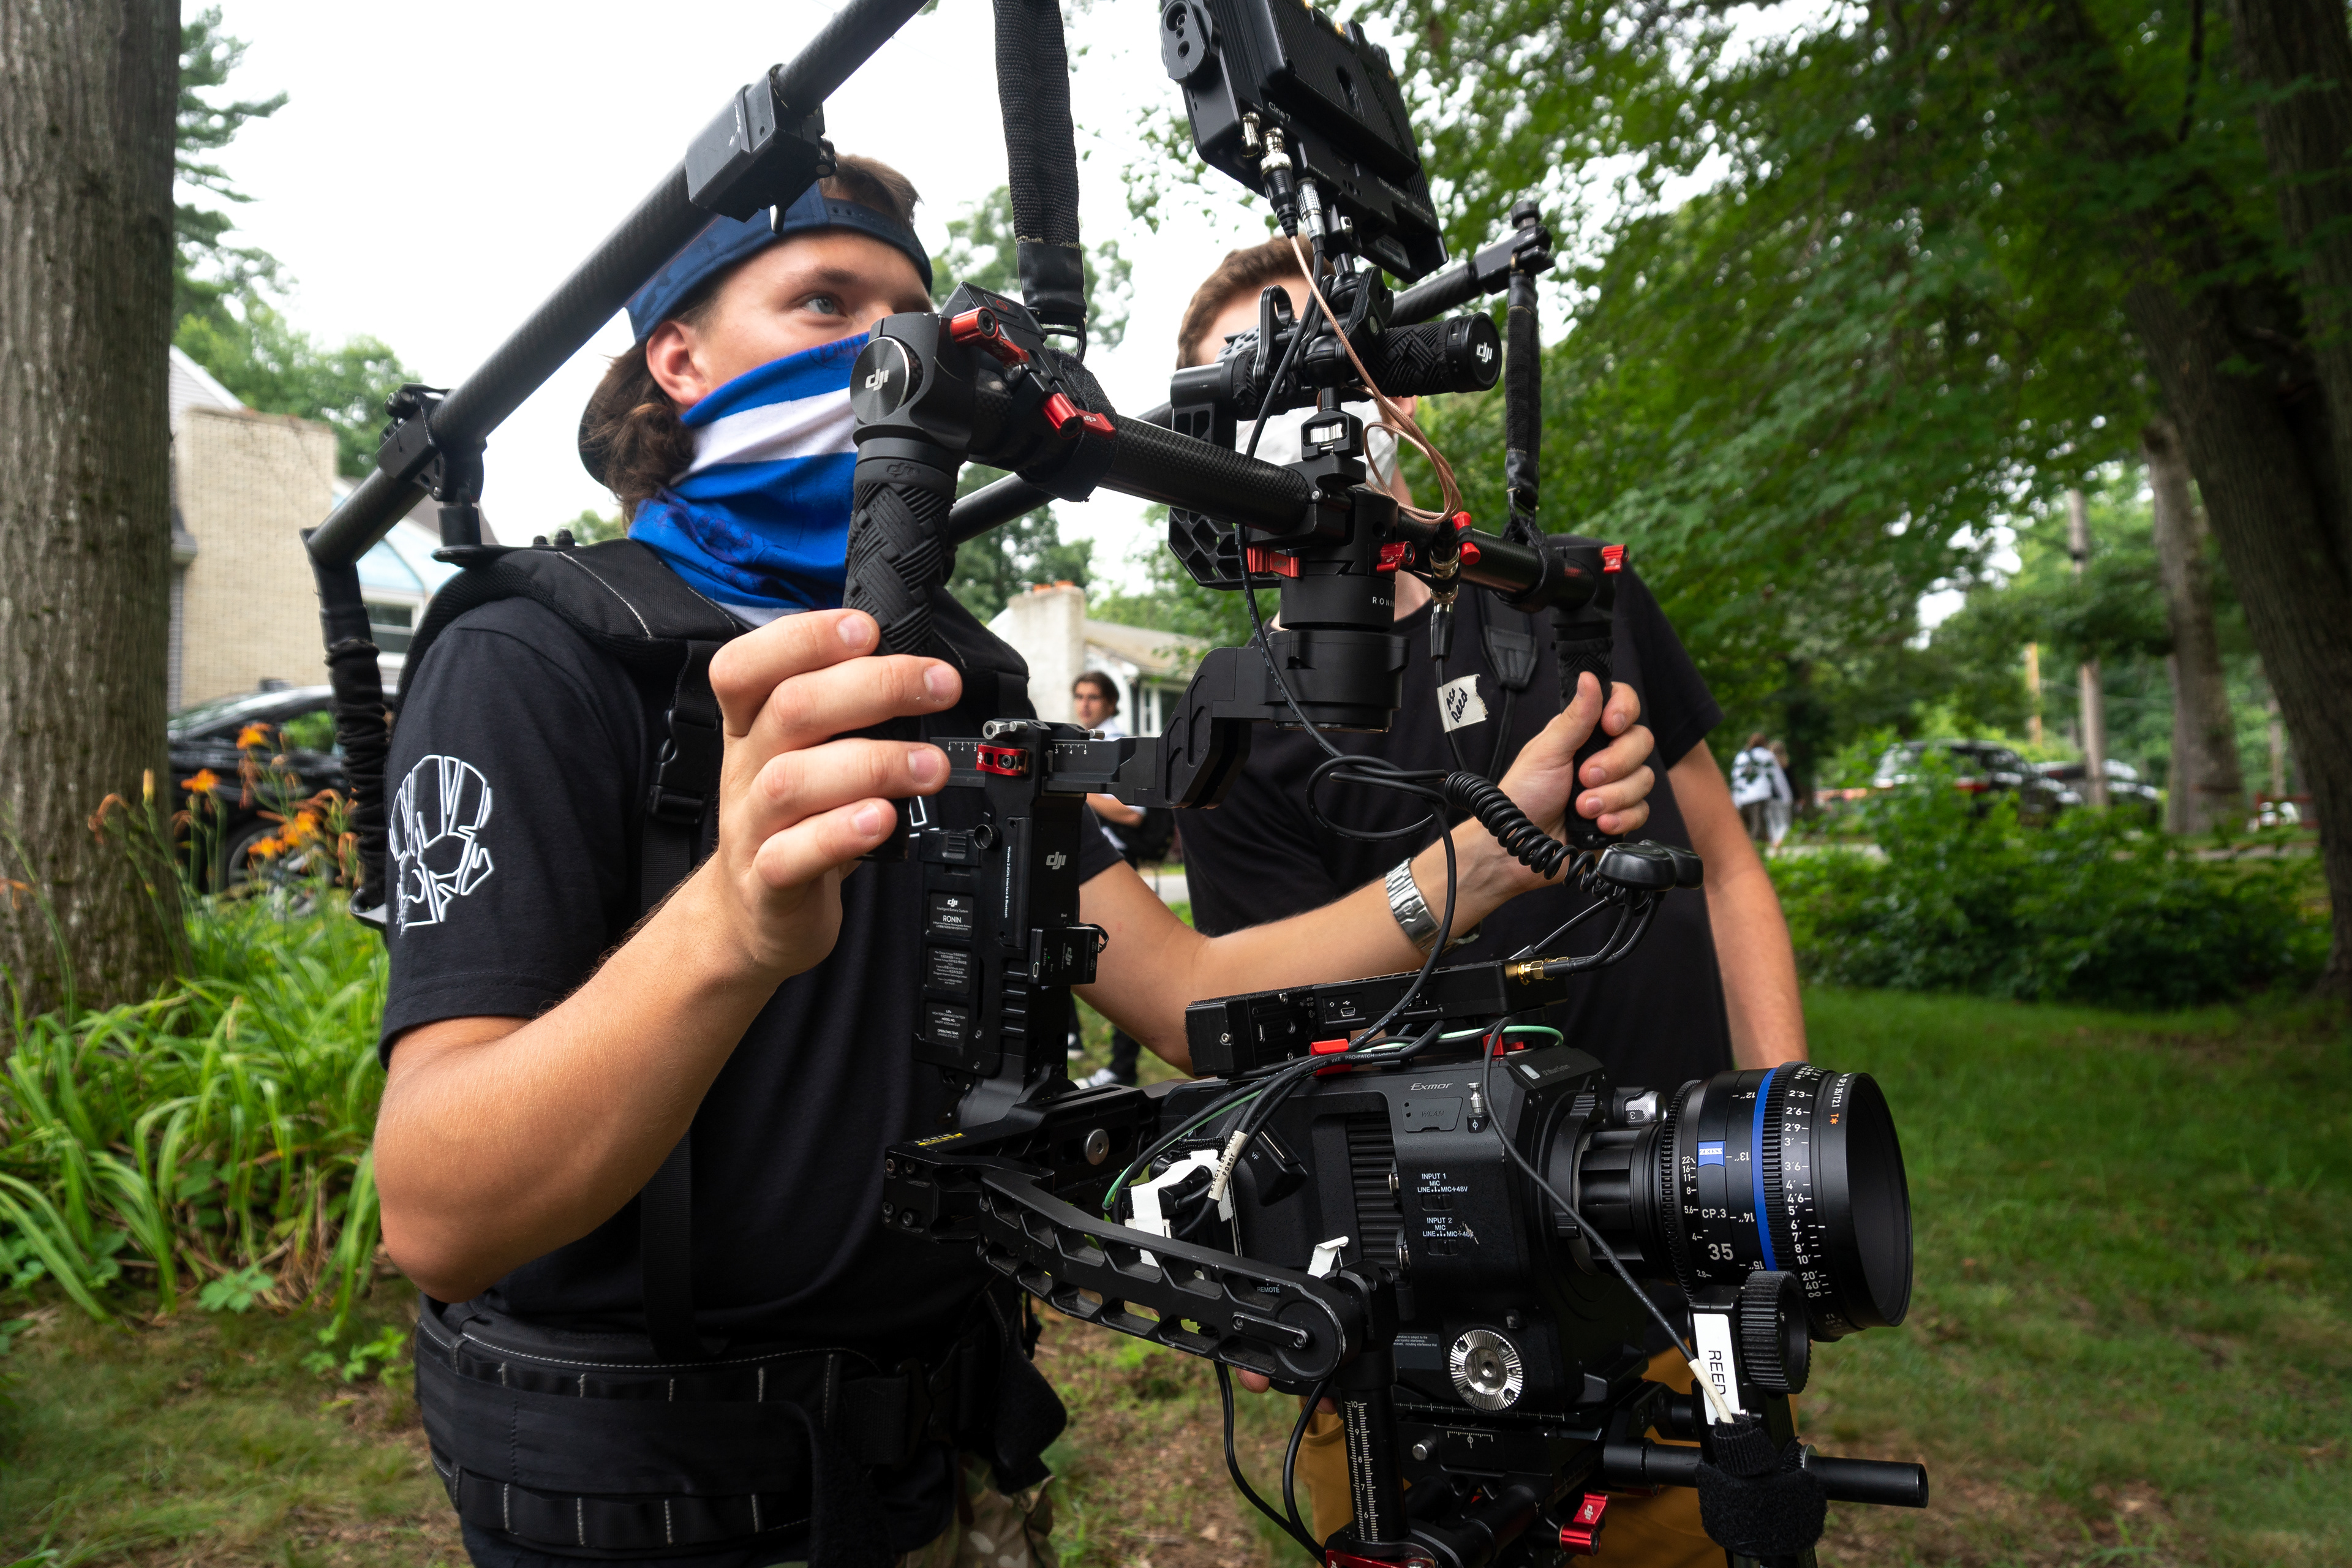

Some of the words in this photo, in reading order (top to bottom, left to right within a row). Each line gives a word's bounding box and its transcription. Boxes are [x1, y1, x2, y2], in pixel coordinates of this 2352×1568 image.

[1268, 102, 1285, 118] Cine
[1286, 113, 1291, 122] 7
[865, 368, 888, 391] dji
[1046, 851, 1066, 870] dji
[947, 898, 958, 908] dji
[943, 915, 962, 924] RONIN
[1065, 947, 1073, 966] dji
[1306, 1061, 1328, 1073] CLASSIC
[1410, 1082, 1453, 1091] Exmor
[1831, 1088, 1844, 1107] 35/T2.1
[1786, 1107, 1802, 1115] 2'6
[1784, 1123, 1801, 1132] 2'9
[1784, 1137, 1794, 1146] 3'
[1251, 1152, 1259, 1160] VF
[1681, 1156, 1691, 1164] 22
[1683, 1165, 1691, 1174] 16
[1784, 1161, 1801, 1171] 3'6
[1786, 1180, 1796, 1189] 4'
[1686, 1186, 1691, 1195] 8
[1787, 1193, 1804, 1203] 4'6
[1684, 1205, 1694, 1214] 5.6
[1702, 1208, 1727, 1218] CP.3
[1788, 1205, 1798, 1215] 5'
[1791, 1219, 1800, 1230] 6'
[1692, 1232, 1697, 1241] 4
[1792, 1231, 1802, 1242] 7'
[1708, 1243, 1733, 1261] 35
[1795, 1243, 1804, 1253] 8'
[1797, 1254, 1811, 1265] 10'
[1697, 1269, 1706, 1278] 2.8
[1801, 1270, 1817, 1281] 20'
[1806, 1280, 1821, 1290] 40'
[1619, 1272, 1632, 1285] MIC
[1633, 1287, 1657, 1313] CABLE
[1708, 1350, 1726, 1395] REED
